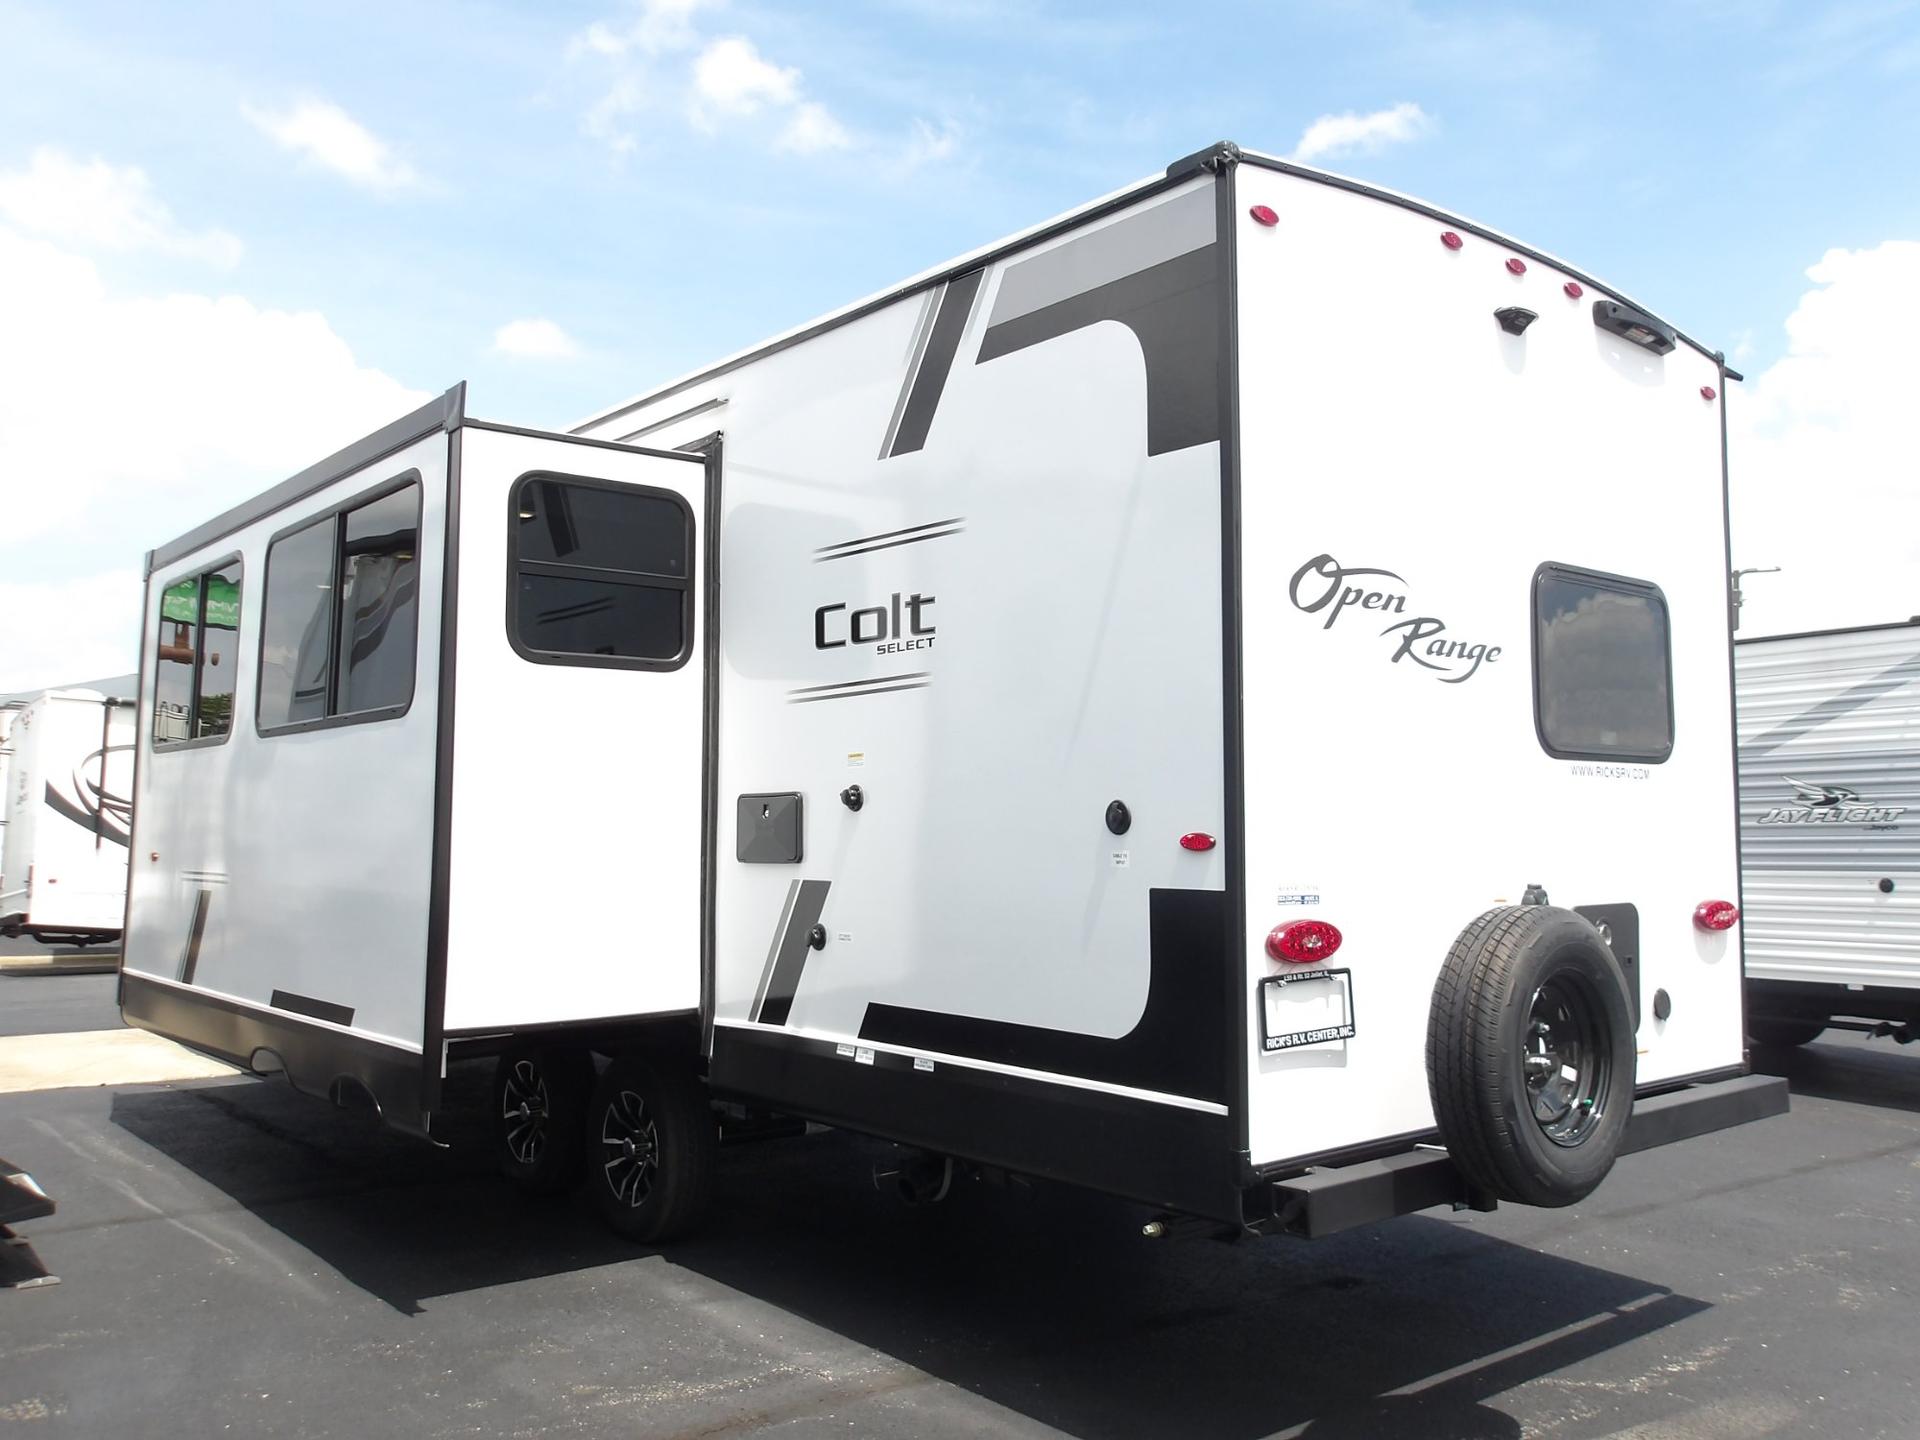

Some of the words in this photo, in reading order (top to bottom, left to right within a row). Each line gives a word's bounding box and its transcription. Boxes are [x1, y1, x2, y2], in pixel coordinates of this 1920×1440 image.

[1289, 553, 1409, 630] Open
[815, 592, 936, 650] Colt
[876, 637, 936, 655] SELECT
[1379, 617, 1502, 684] Range
[1266, 1035, 1293, 1049] RICK'S
[1339, 1025, 1354, 1037] INC.
